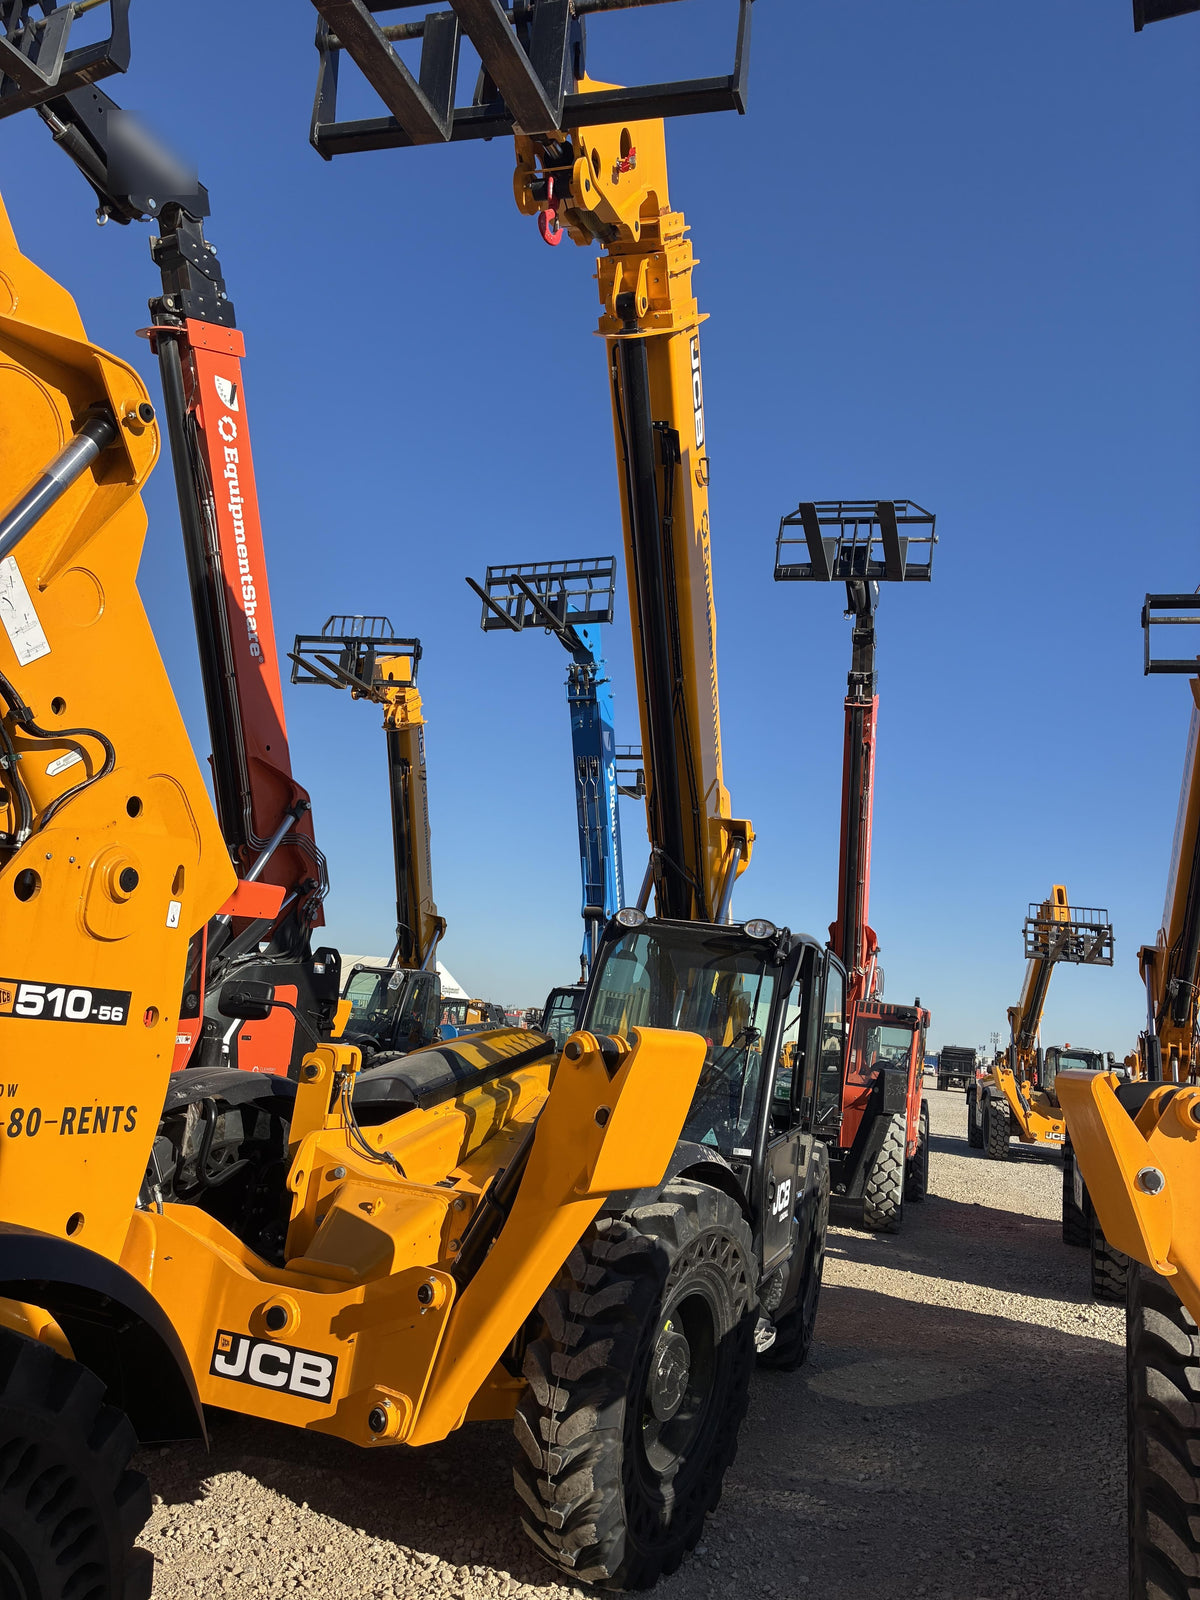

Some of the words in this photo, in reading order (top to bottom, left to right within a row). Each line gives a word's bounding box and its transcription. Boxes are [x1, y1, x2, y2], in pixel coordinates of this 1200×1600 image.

[691, 339, 704, 447] JCB
[16, 984, 124, 1021] 510-56
[772, 1179, 791, 1215] JCB
[214, 1338, 333, 1397] JCB
